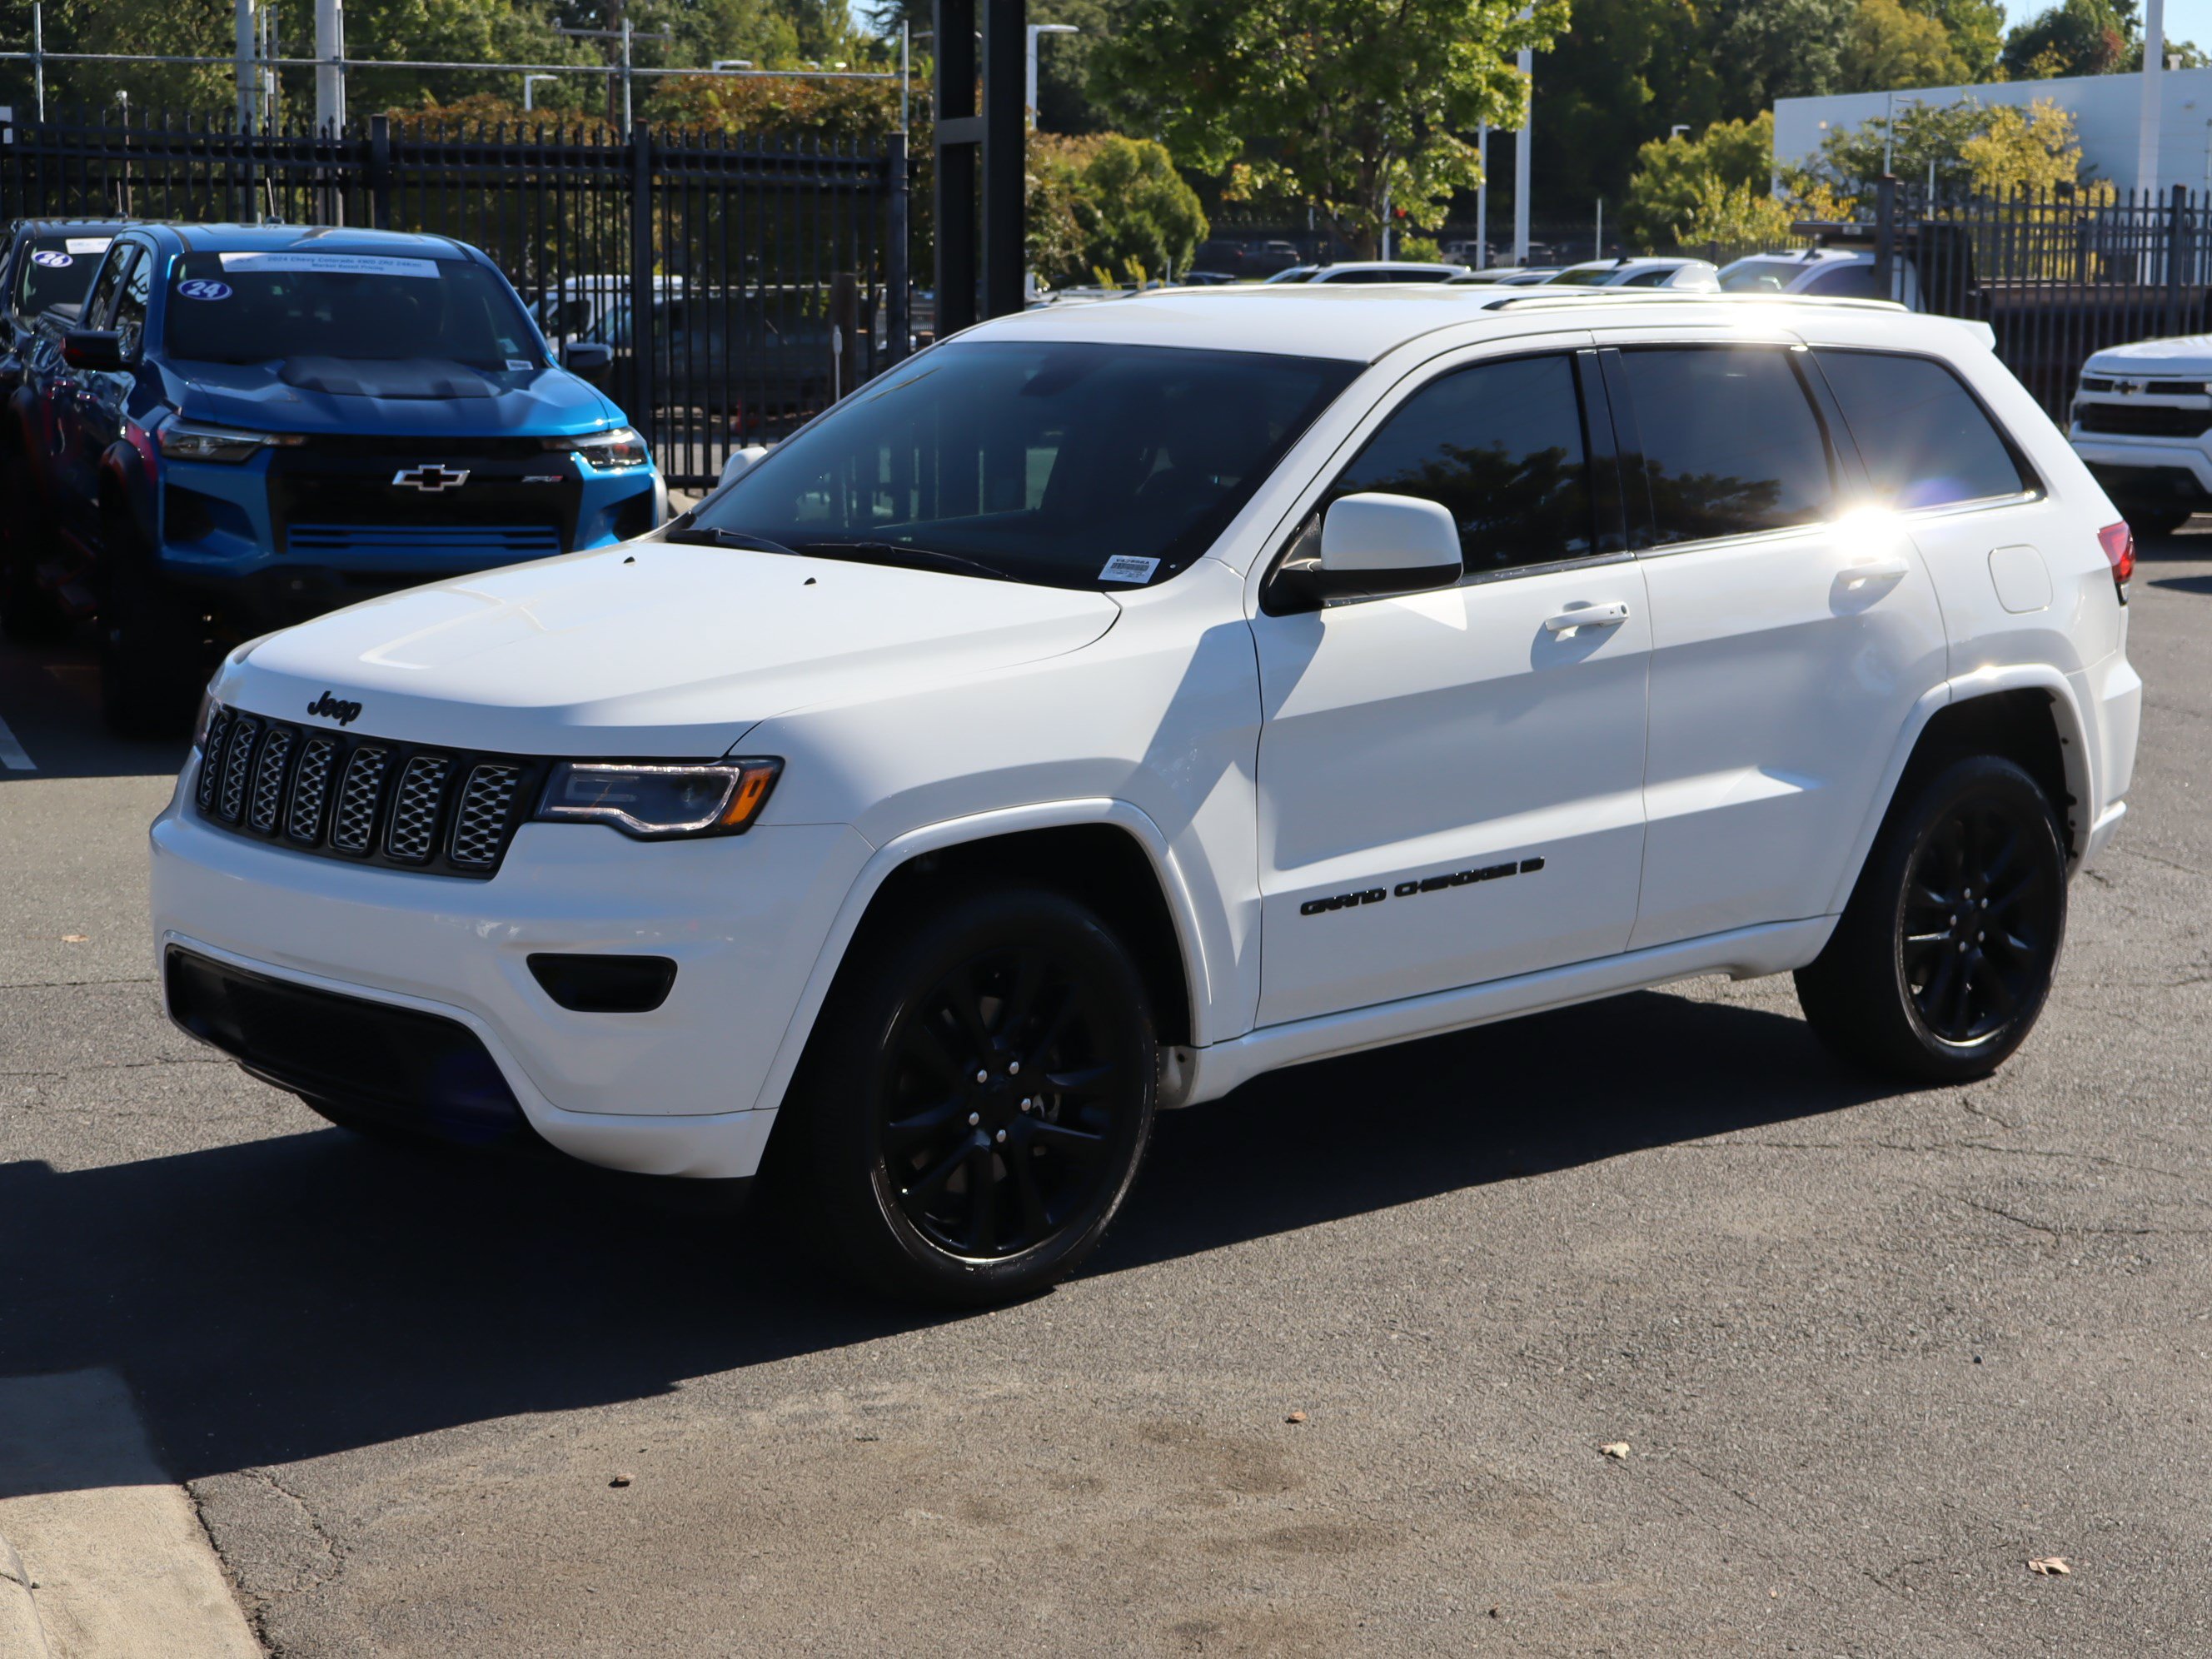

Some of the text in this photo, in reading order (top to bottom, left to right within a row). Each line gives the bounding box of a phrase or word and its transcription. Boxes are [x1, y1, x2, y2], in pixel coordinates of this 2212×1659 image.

[38, 253, 65, 267] 26
[187, 281, 222, 298] 24
[306, 690, 362, 727] Jeep
[1300, 856, 1545, 915] GRAND CHEROKEE
